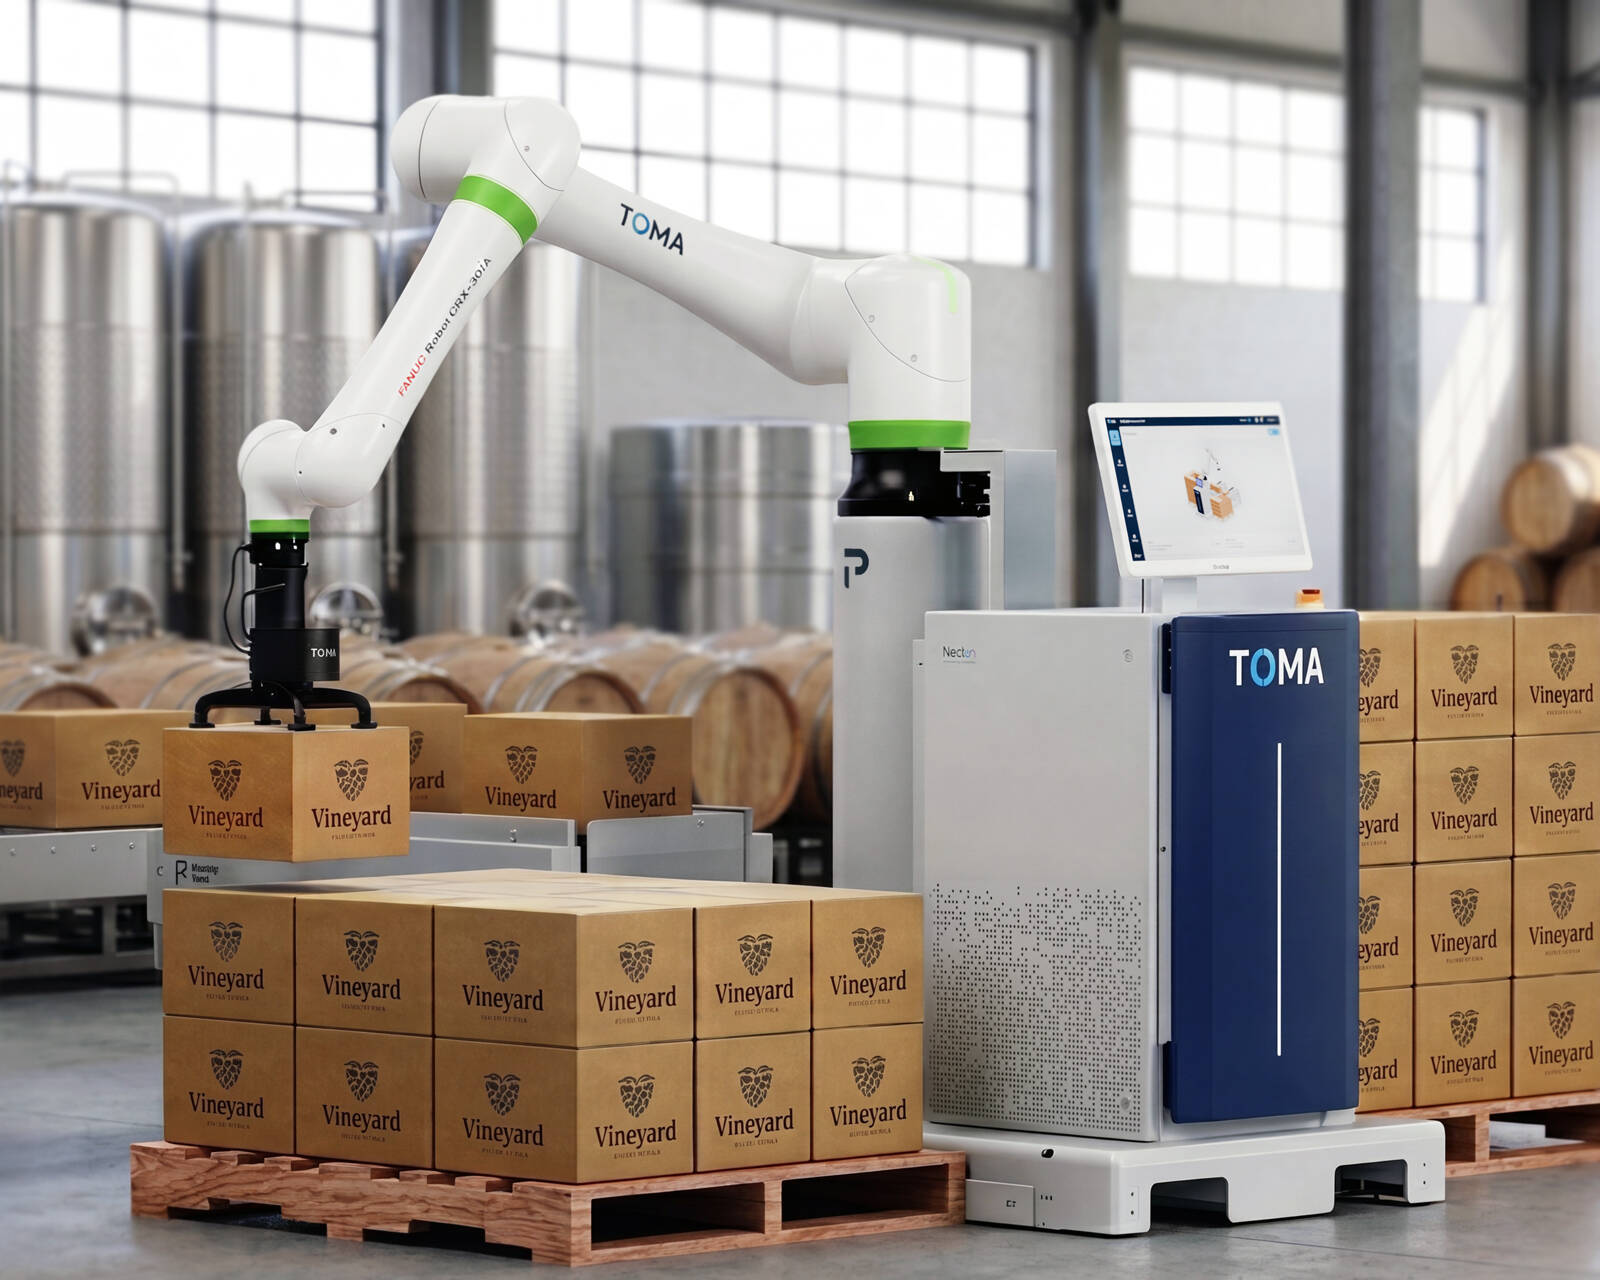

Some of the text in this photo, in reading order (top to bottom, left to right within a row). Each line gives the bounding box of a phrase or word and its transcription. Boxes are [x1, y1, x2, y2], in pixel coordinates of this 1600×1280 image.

[620, 203, 684, 256] TOMA
[398, 354, 426, 397] FANUC
[425, 318, 451, 354] Robot
[1229, 647, 1324, 687] TOMA
[1358, 688, 1399, 716] eyard
[1431, 685, 1498, 712] Vineyard
[1529, 682, 1594, 708] Vineyard
[81, 779, 161, 803] Vineyard
[485, 786, 557, 812] Vineyard
[602, 787, 676, 813] Vineyard
[188, 804, 264, 832] Vineyard
[311, 804, 392, 832] Vineyard
[1358, 812, 1399, 839] eyard
[1431, 807, 1498, 834] Vineyard
[1529, 801, 1594, 827] Vineyard
[1430, 928, 1497, 955] Vineyard
[1529, 921, 1594, 947] Vineyard
[1358, 935, 1399, 963] eyard
[188, 965, 265, 993] Vineyard
[322, 974, 401, 1002] Vineyard
[715, 977, 794, 1007] Vineyard
[830, 969, 907, 998] Vineyard
[462, 984, 544, 1013] Vineyard
[595, 985, 677, 1015] Vineyard
[1430, 1049, 1497, 1076] Vineyard
[1529, 1040, 1594, 1067] Vineyard
[1358, 1058, 1397, 1086] eyard
[189, 1091, 265, 1120] Vineyard
[322, 1104, 401, 1133] Vineyard
[830, 1098, 907, 1128] Vineyard
[462, 1117, 544, 1148] Vineyard
[595, 1119, 677, 1149] Vineyard
[715, 1108, 794, 1138] Vineyard
